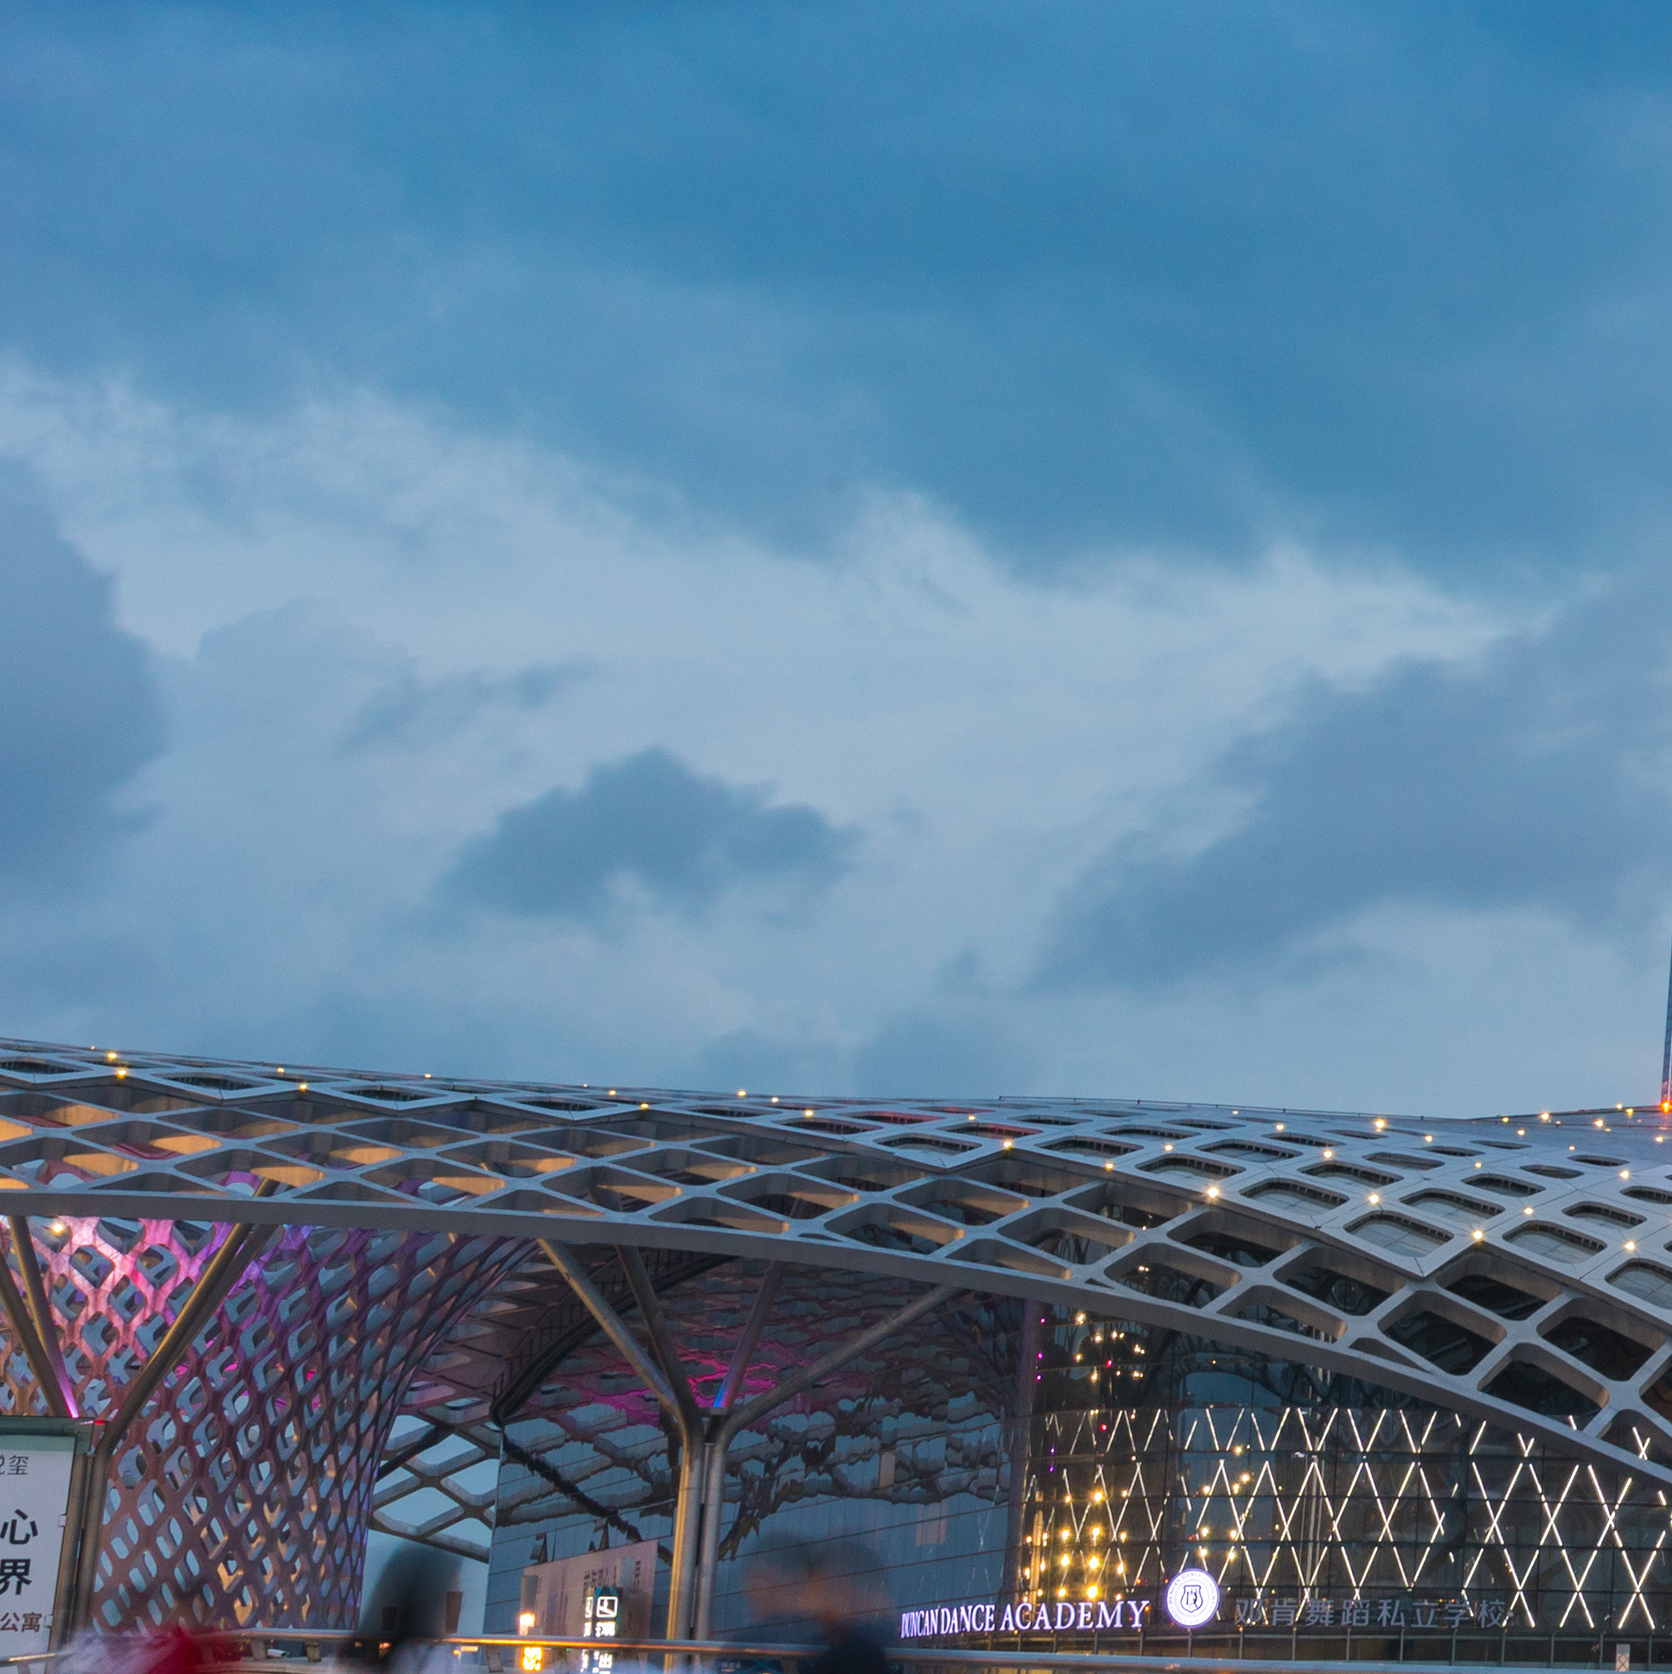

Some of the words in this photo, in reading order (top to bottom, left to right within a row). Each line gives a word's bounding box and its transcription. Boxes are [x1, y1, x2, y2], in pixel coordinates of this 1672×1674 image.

[0, 1454, 29, 1476] 玺
[0, 1612, 42, 1633] 公寓
[900, 1605, 941, 1639] DUNCAN
[939, 1603, 996, 1635] DANCE
[1000, 1599, 1150, 1631] ACADEMY
[1234, 1597, 1506, 1629] 邓肯舞蹈私立学校
